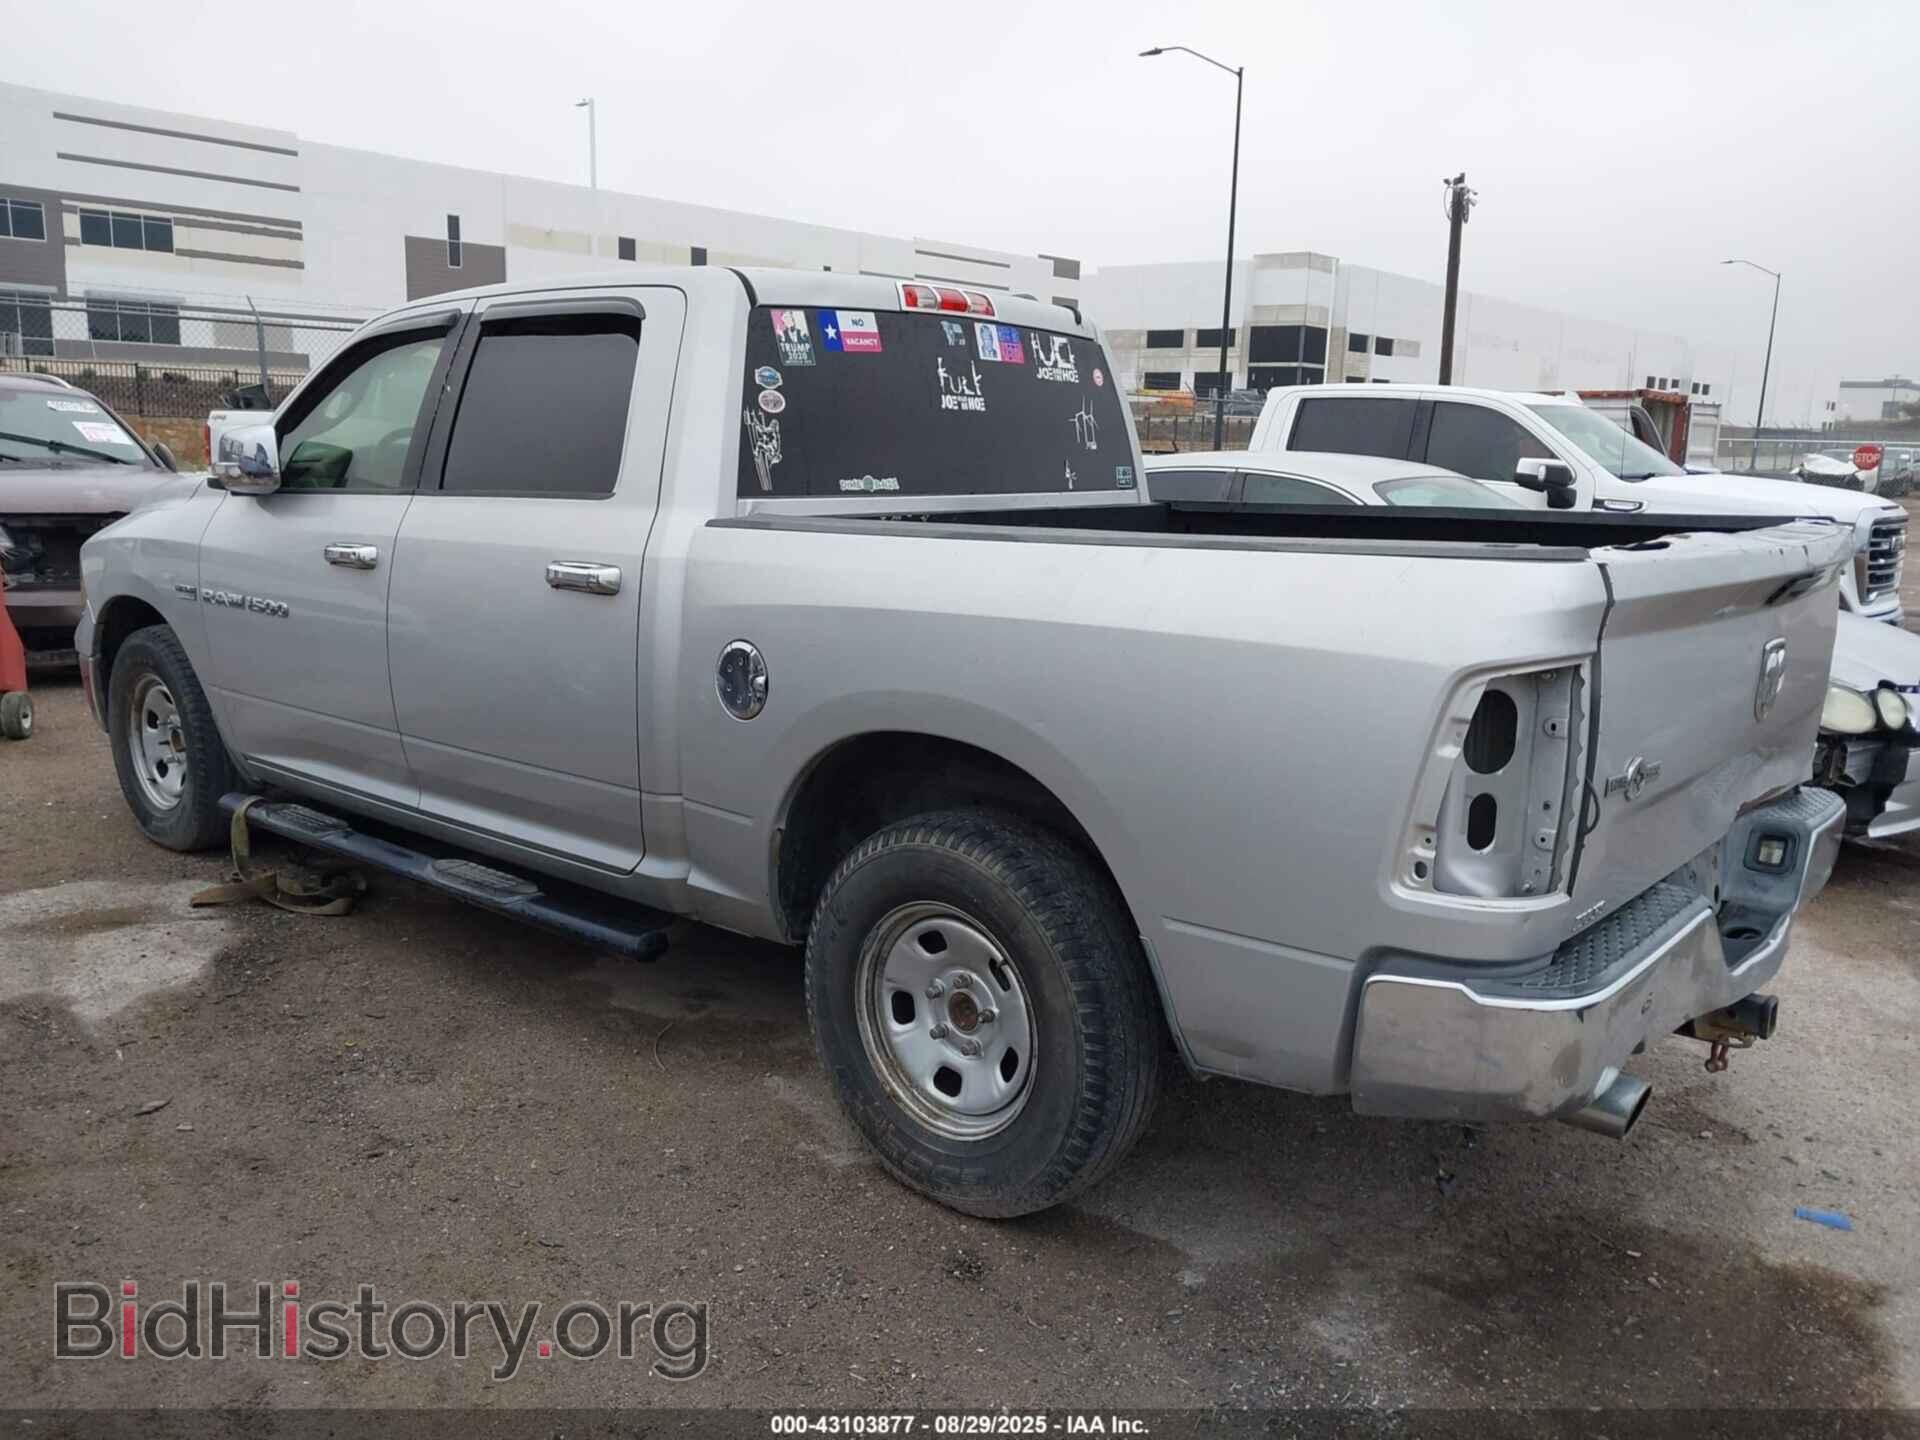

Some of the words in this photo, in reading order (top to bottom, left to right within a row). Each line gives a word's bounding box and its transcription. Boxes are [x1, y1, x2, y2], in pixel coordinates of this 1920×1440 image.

[851, 318, 865, 327] NO
[780, 342, 812, 353] TRUMP
[845, 337, 879, 347] VACANCY
[1036, 367, 1053, 381] JOE
[941, 394, 959, 410] JOE
[1855, 452, 1881, 464] STOP
